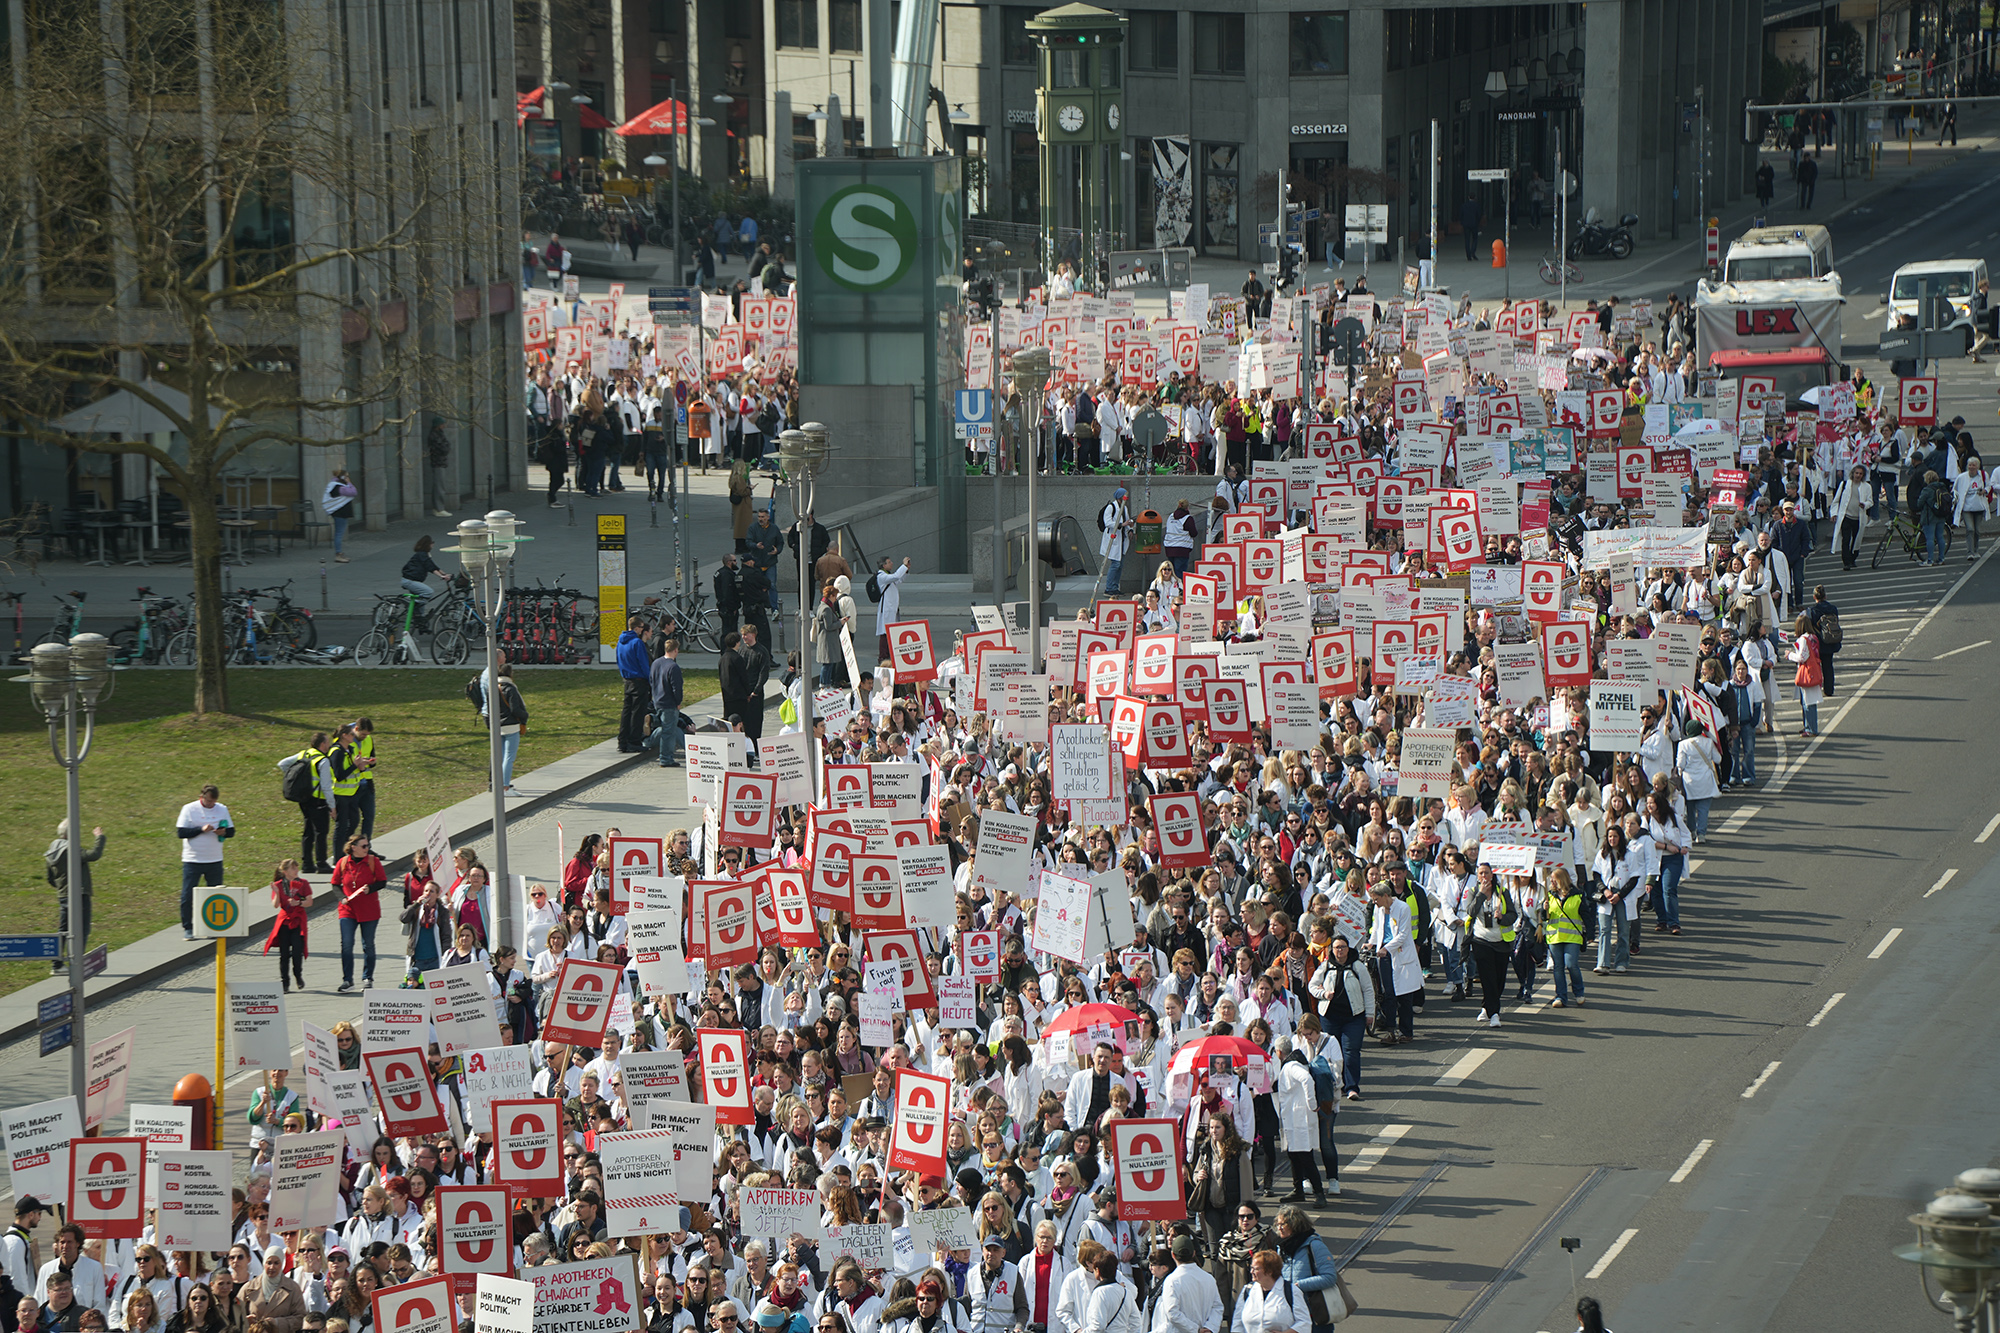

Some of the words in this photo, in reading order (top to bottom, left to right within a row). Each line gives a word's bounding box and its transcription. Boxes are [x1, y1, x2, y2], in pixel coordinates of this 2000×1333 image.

[1498, 112, 1536, 121] PANORAMA
[1291, 123, 1347, 135] essenza
[831, 192, 901, 284] S
[1114, 271, 1150, 288] MLM
[1737, 308, 1800, 335] LEX
[961, 391, 985, 421] U
[1646, 435, 1671, 443] STOP
[601, 519, 622, 527] Jelbi
[1599, 693, 1633, 702] RZNEI
[819, 698, 845, 710] APOTHEKEN
[1596, 702, 1636, 711] MITTEL
[825, 708, 849, 723] JETZT!
[1063, 761, 1098, 776] Problem
[1083, 805, 1119, 821] Placebo
[1164, 821, 1195, 832] NULLTARIF!
[212, 902, 228, 923] H
[869, 967, 896, 980] Fixum
[879, 975, 895, 987] rauf
[944, 979, 971, 989] Sankt
[940, 990, 972, 998] Nimmerlein
[942, 1008, 973, 1019] HEUTE
[860, 1017, 890, 1028] INFLATION
[493, 1050, 513, 1062] WIR
[490, 1060, 525, 1073] HELFEN
[469, 1079, 486, 1092] TAG
[491, 1076, 498, 1088] &
[502, 1073, 525, 1088] NACHT
[9, 1122, 26, 1131] IHR
[29, 1113, 62, 1126] MACHT
[905, 1111, 938, 1125] NULLTARIF!
[11, 1126, 52, 1140] POLITIK.
[14, 1150, 33, 1158] WIR
[36, 1140, 70, 1154] MACHE
[295, 1143, 338, 1153] KOALITIONS-
[509, 1139, 549, 1148] NULLTARIF!
[14, 1155, 48, 1169] DICHT.
[280, 1153, 312, 1162] VERTRAG
[298, 1157, 332, 1167] PLACEBO.
[615, 1154, 661, 1164] APOTHEKEN
[607, 1161, 671, 1172] KAPUTTSPAREN?
[1128, 1159, 1168, 1170] NULLTARIF!
[277, 1176, 299, 1184] JETZT
[607, 1172, 622, 1180] MIT
[624, 1171, 641, 1179] UNS
[644, 1169, 671, 1177] NICHT!
[86, 1178, 130, 1187] NULLTARIF!
[277, 1182, 306, 1191] HALTEN!
[746, 1190, 816, 1206] APOTHEKEN
[913, 1209, 966, 1225] GESUND-
[755, 1216, 802, 1234] JETZT
[933, 1220, 955, 1231] HEIT
[453, 1229, 496, 1238] NULLTARIF!
[827, 1228, 843, 1238] WIR
[851, 1225, 886, 1235] HELFEN
[839, 1236, 882, 1248] TÄGLICH
[860, 1247, 884, 1258] HILFT
[551, 1267, 613, 1284] APOTHEKEN
[533, 1317, 630, 1333] PATIENTENLEBEN
